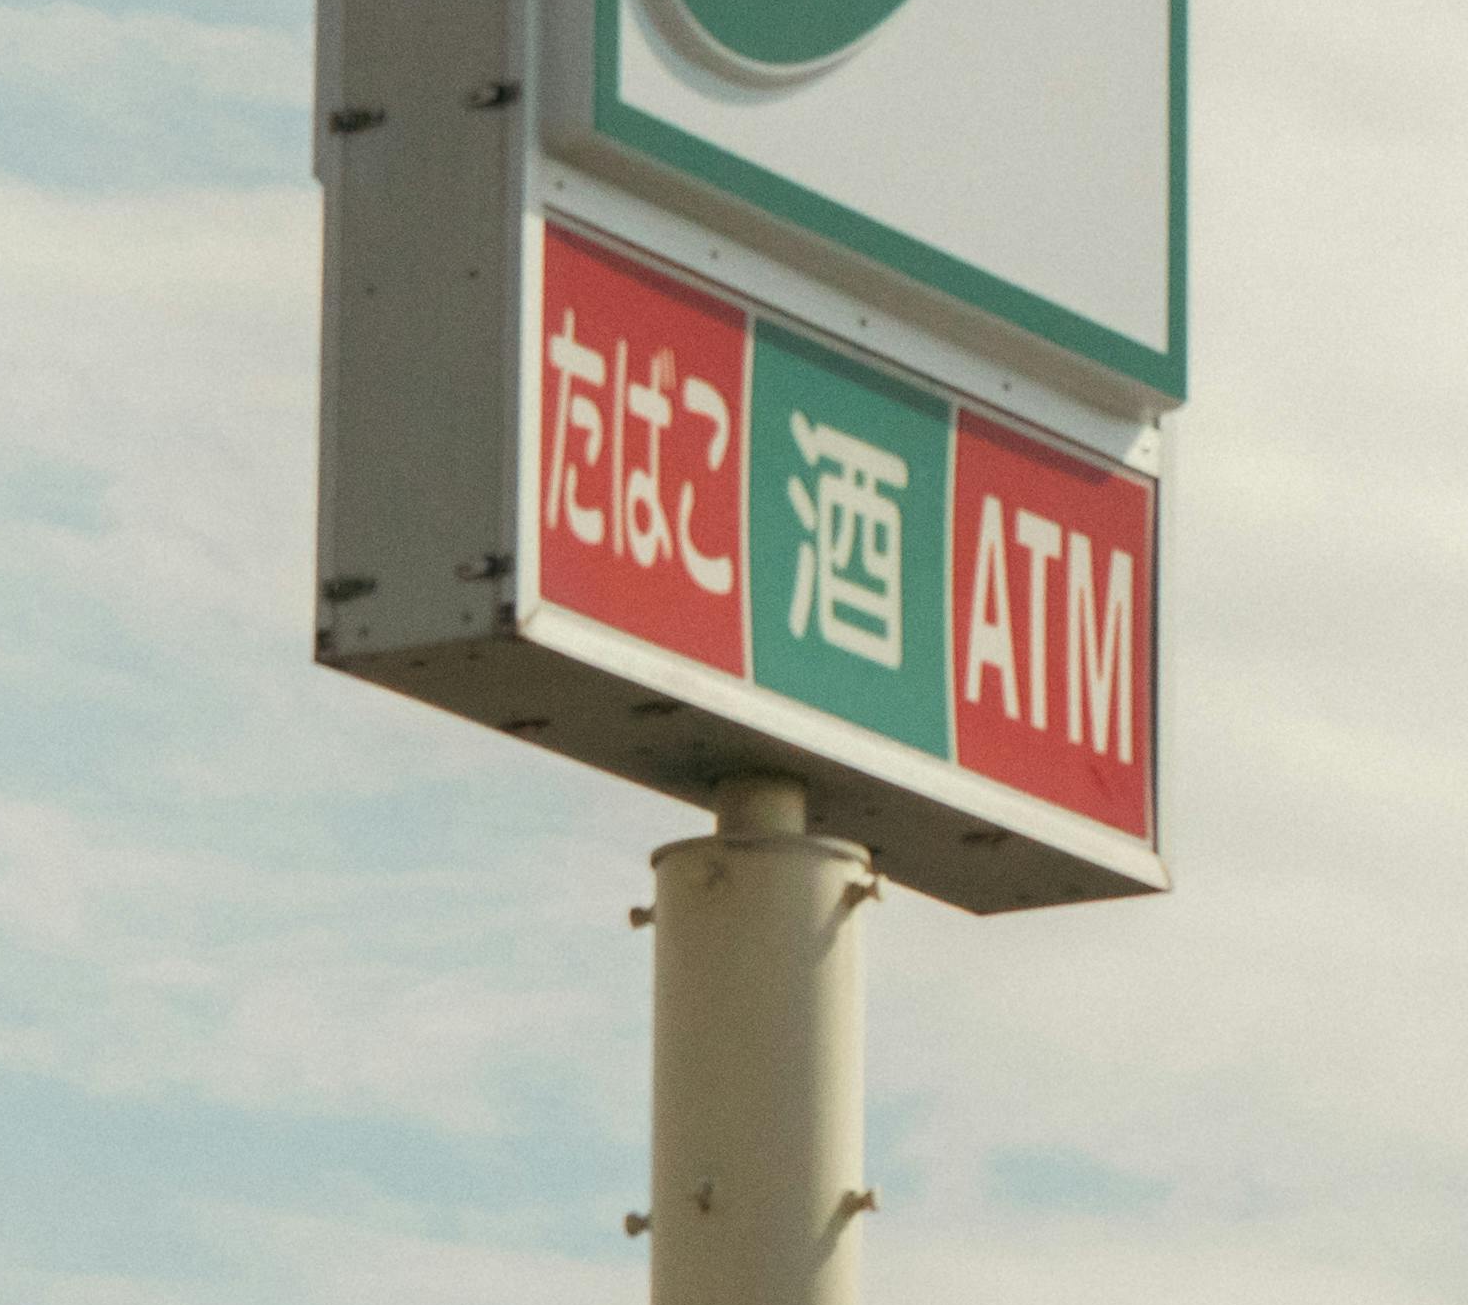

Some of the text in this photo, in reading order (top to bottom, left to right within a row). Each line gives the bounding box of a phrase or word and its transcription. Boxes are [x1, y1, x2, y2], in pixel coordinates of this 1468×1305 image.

[547, 308, 733, 594] たばこ
[789, 410, 910, 670] 酒
[965, 495, 1134, 765] ATM
